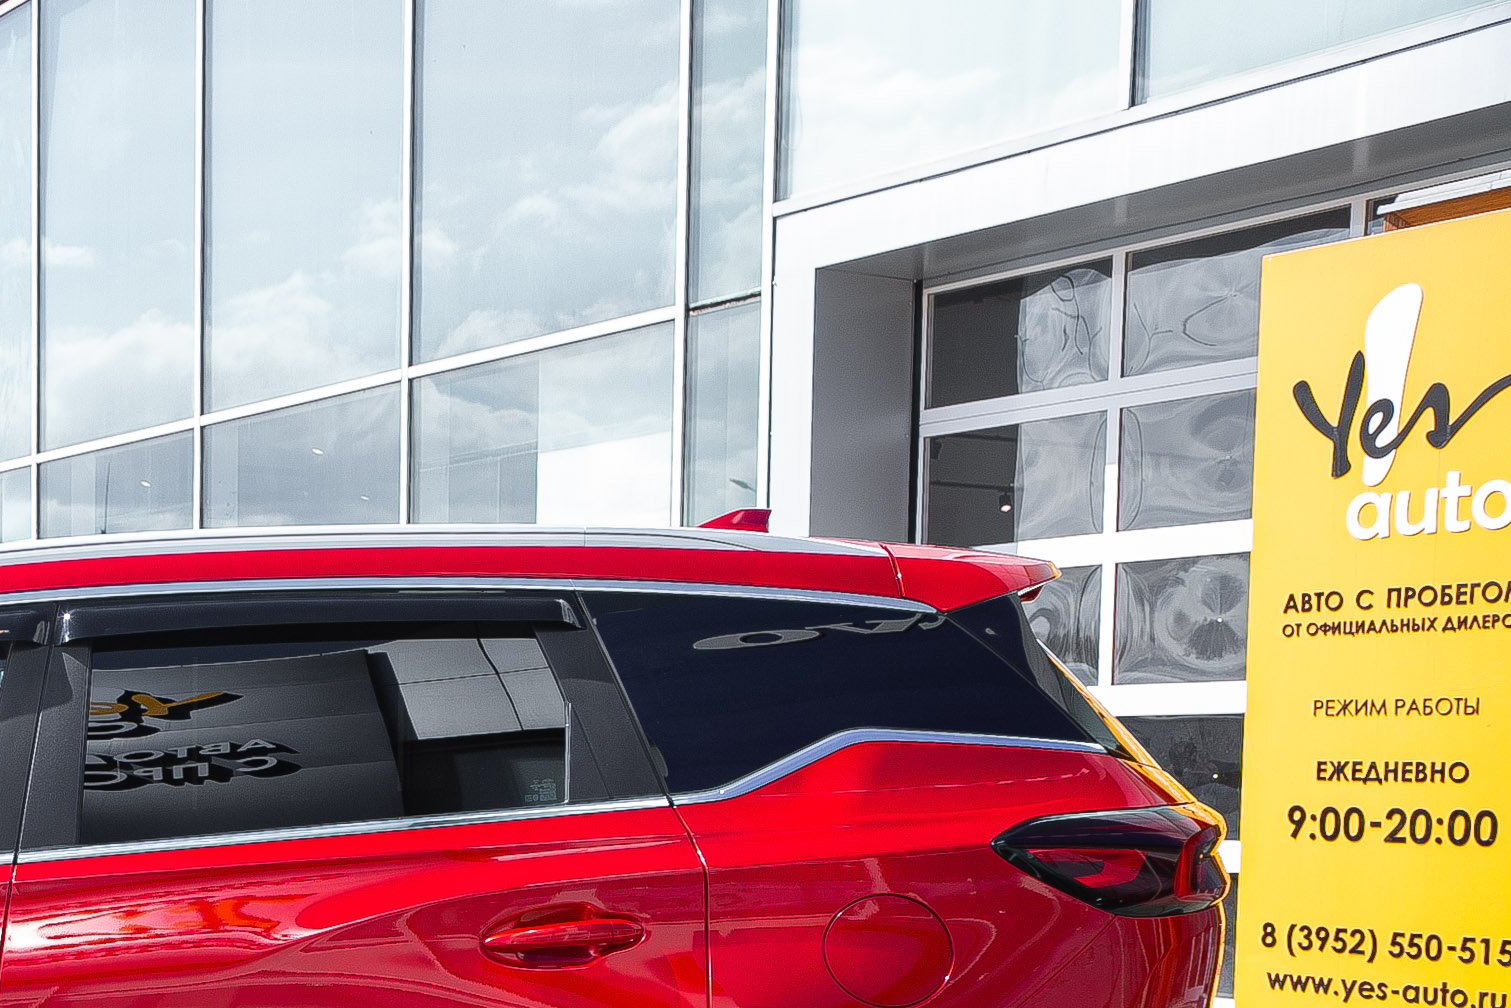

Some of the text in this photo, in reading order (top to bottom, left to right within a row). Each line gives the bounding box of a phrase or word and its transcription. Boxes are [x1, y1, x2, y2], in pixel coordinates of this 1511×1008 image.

[1292, 350, 1511, 479] Yes
[1345, 470, 1511, 541] auto
[1283, 591, 1344, 614] АВТО
[1355, 588, 1375, 612] С
[1282, 623, 1302, 639] ОТ
[1306, 616, 1439, 638] ОФИЦИАЛЬНЫХ
[1313, 696, 1481, 718] РЕЖИМ РАБОТЫ
[1316, 760, 1471, 786] ЕЖЕДНЕВНО
[1288, 804, 1500, 848] 9:00-20:00
[1261, 921, 1511, 968] 8 (3952) 550-515
